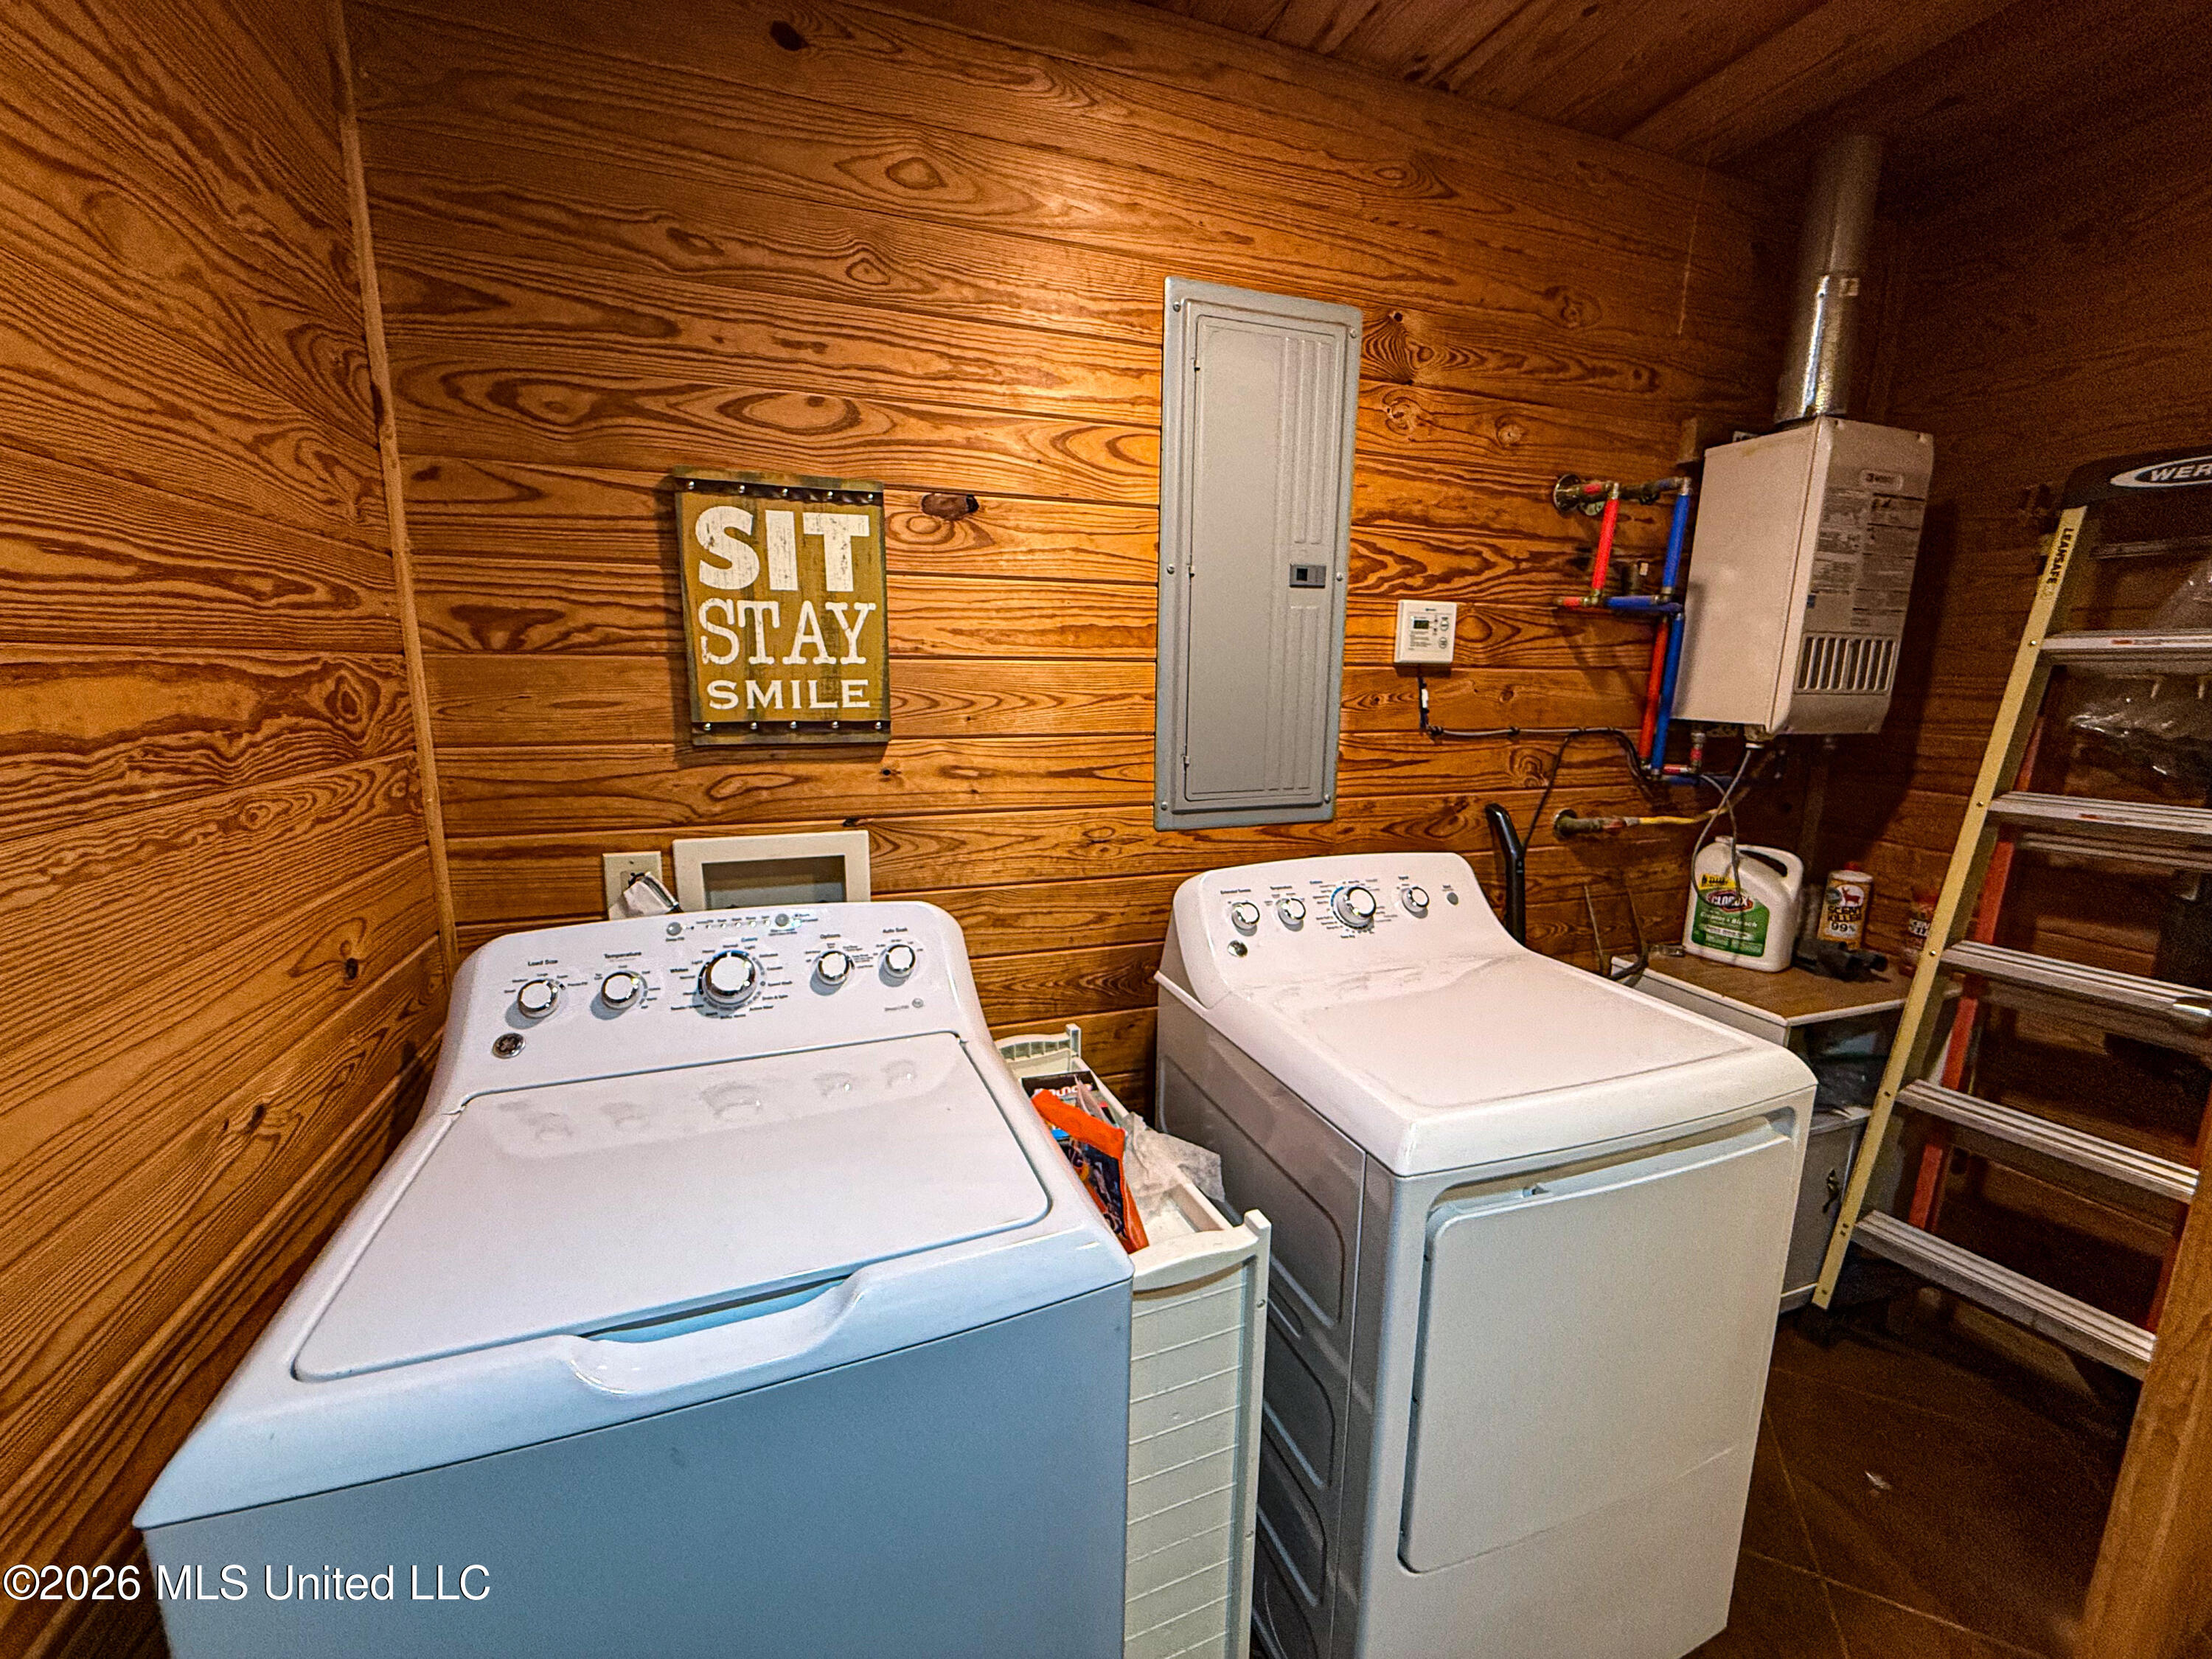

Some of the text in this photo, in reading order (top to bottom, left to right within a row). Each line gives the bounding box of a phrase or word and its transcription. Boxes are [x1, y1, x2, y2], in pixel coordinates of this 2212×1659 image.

[695, 505, 870, 592] SIT
[698, 598, 877, 664] STAY
[706, 679, 871, 710] SMILE
[604, 951, 641, 959] Temperature
